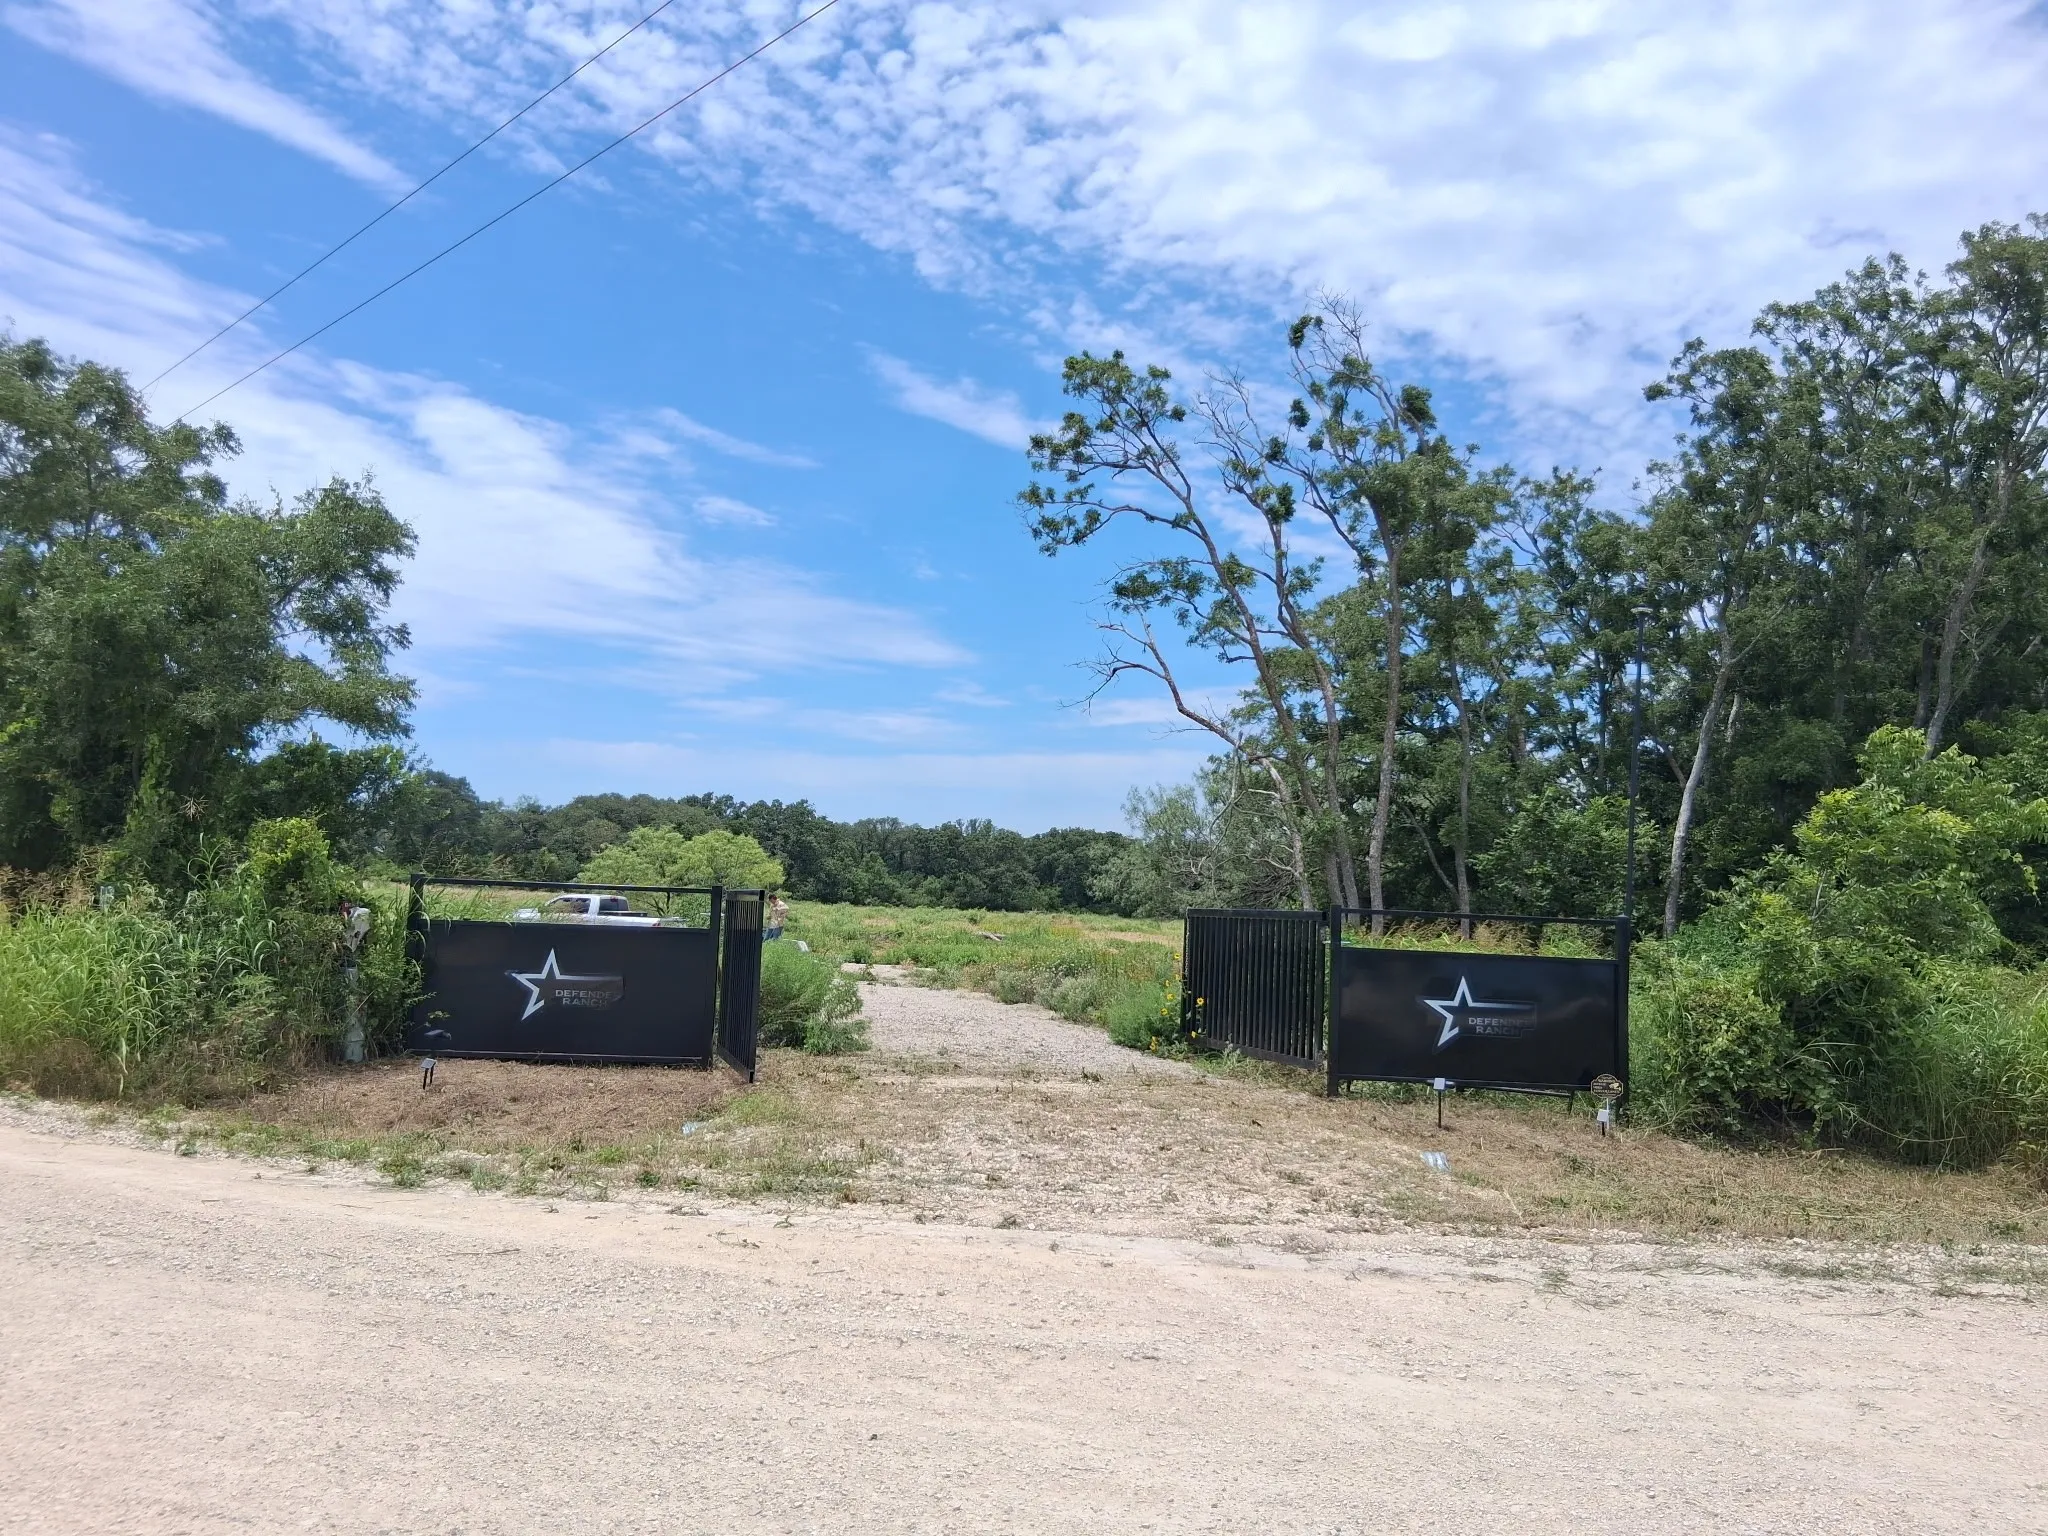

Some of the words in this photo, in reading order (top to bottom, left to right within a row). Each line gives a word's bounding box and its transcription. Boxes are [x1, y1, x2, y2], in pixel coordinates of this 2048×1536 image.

[555, 989, 617, 999] DEFENDE
[562, 997, 607, 1007] RANCH
[1468, 1017, 1529, 1027] DEFENDE
[1475, 1026, 1519, 1036] RANCH
